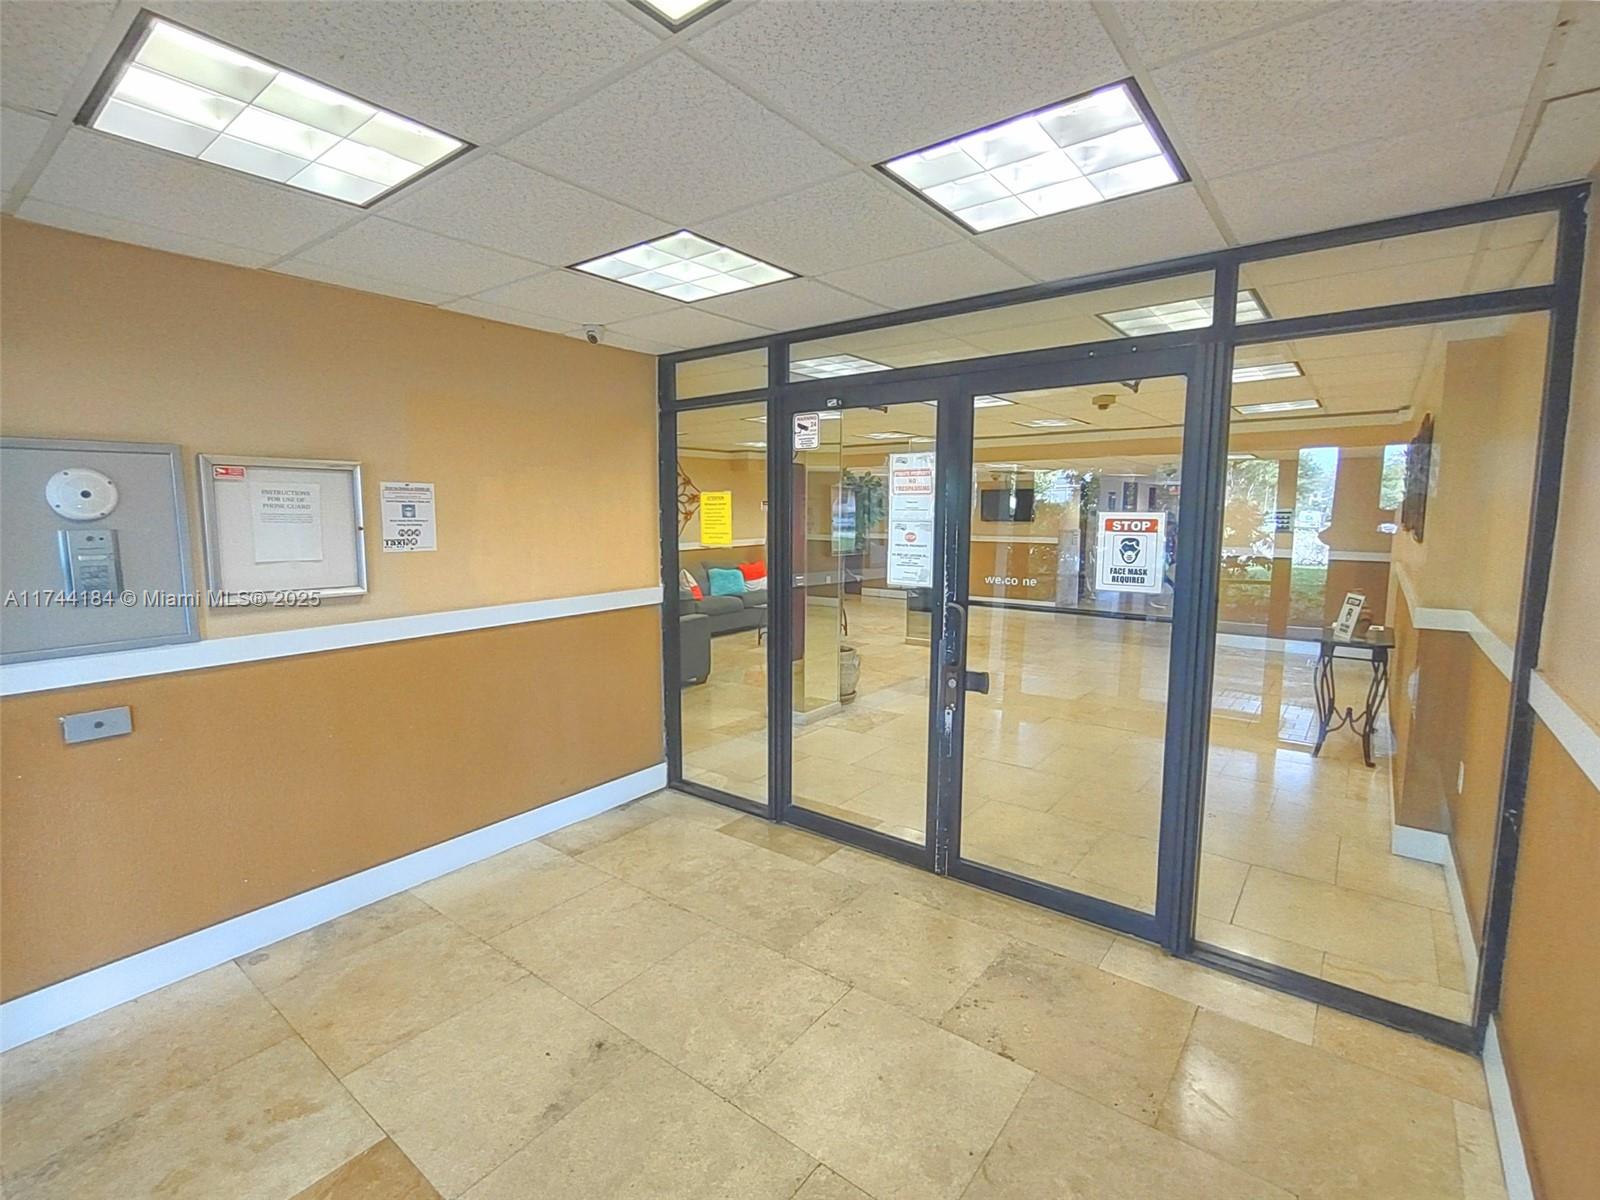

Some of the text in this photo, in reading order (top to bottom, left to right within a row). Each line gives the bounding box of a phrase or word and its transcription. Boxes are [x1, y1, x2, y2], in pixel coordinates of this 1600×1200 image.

[1112, 521, 1151, 531] STOP
[1109, 567, 1148, 576] FACE MASK
[1111, 575, 1145, 584] REQUIRED
